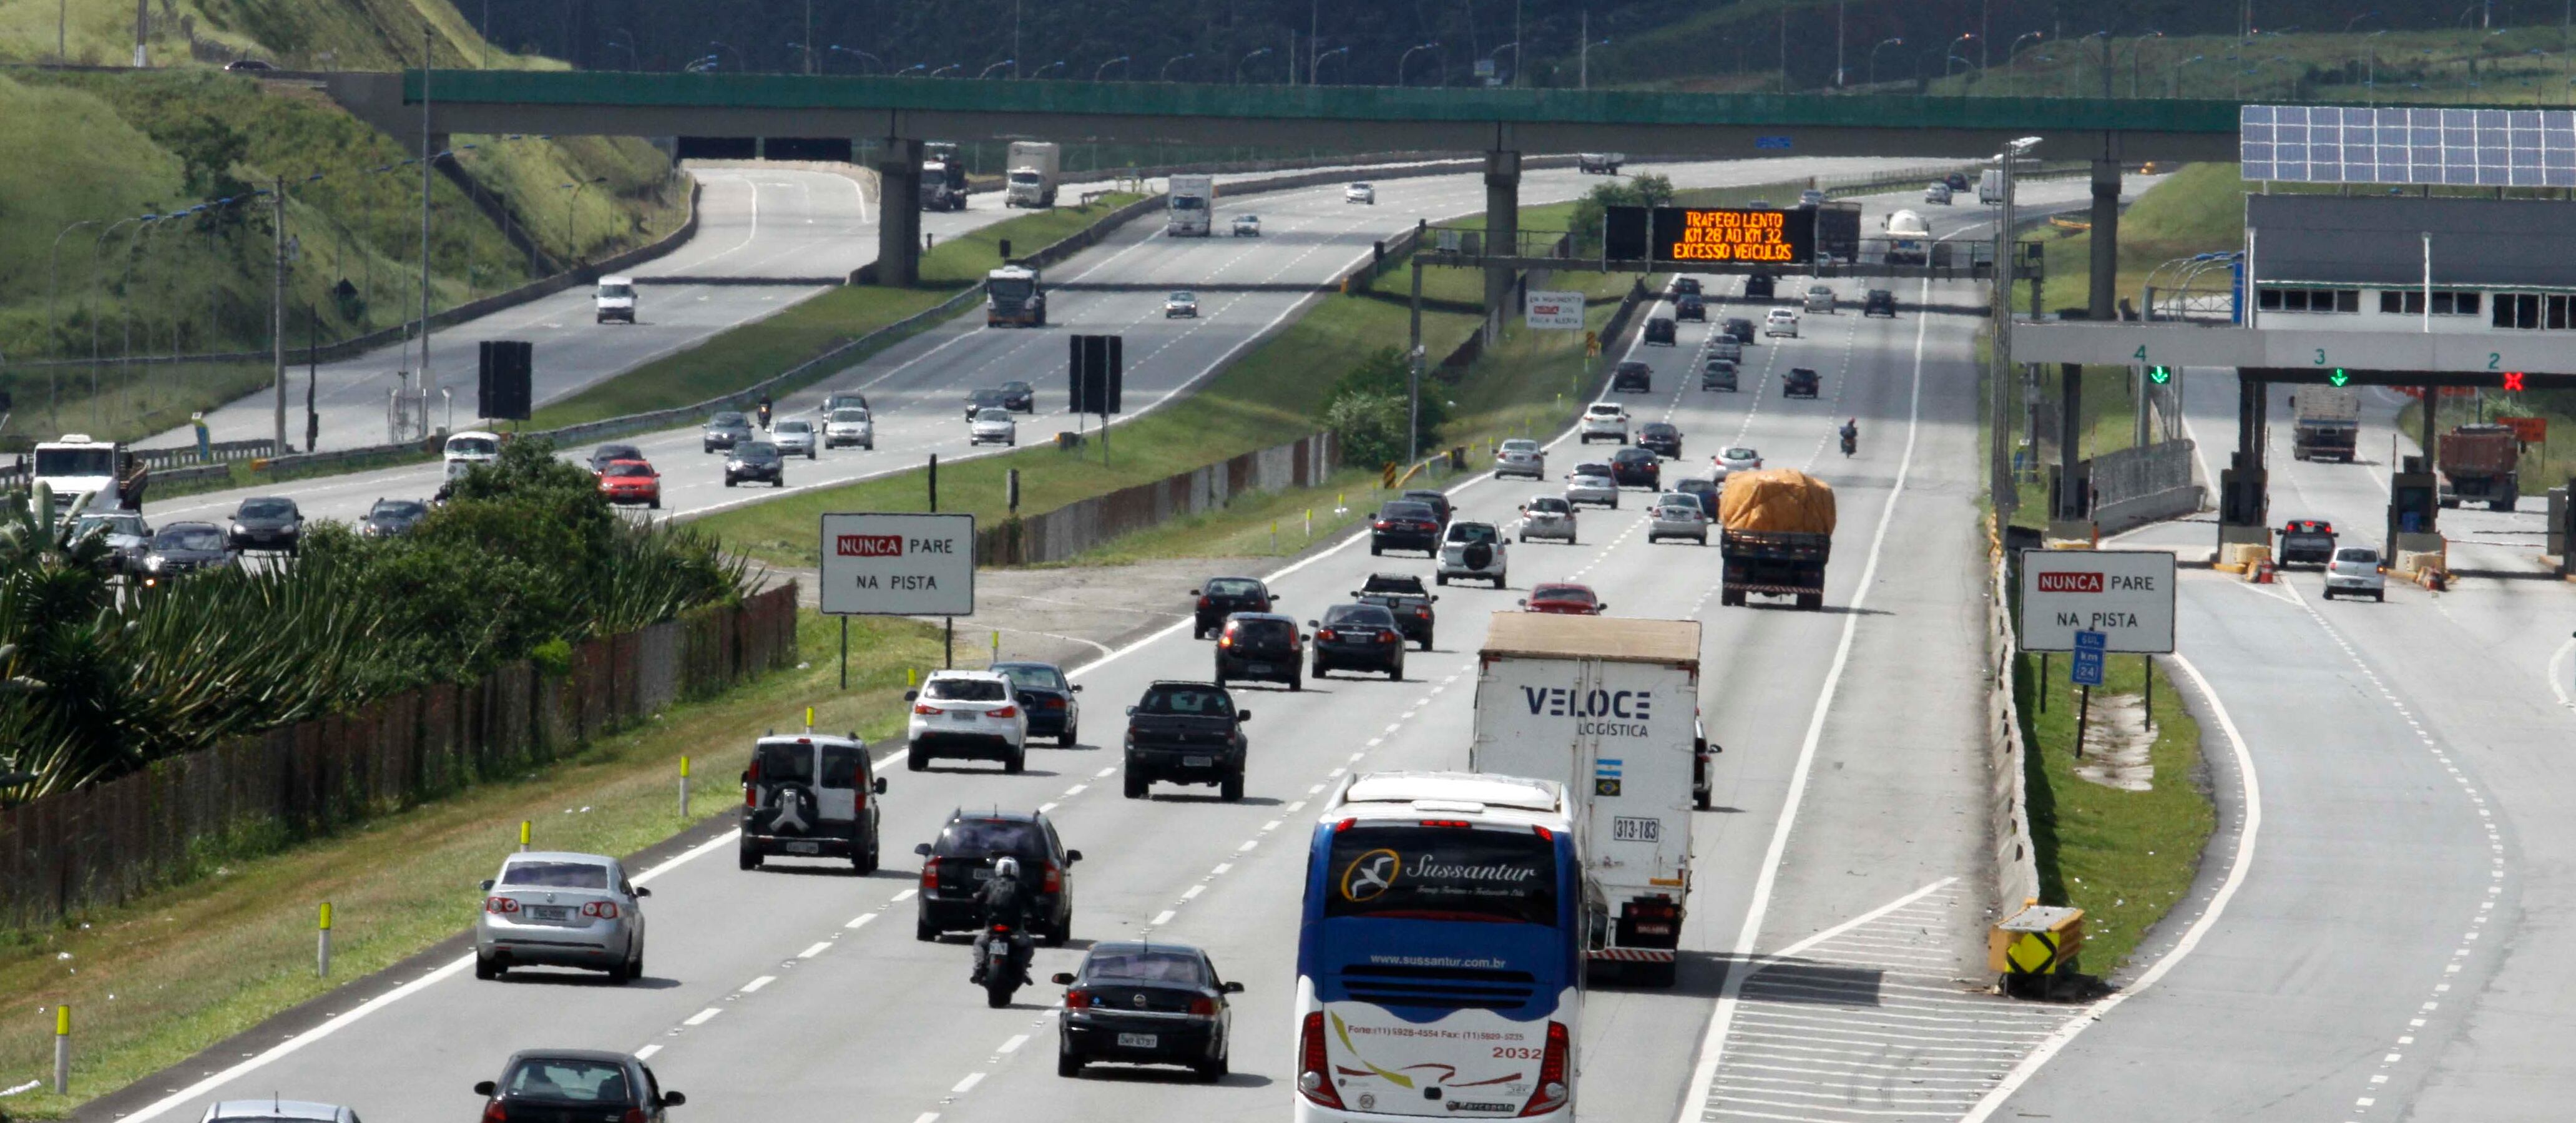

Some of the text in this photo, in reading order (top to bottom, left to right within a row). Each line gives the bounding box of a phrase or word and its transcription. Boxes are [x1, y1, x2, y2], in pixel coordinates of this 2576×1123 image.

[1743, 213, 1783, 228] LENTO
[1685, 228, 1781, 243] KM 28 AO KM 32
[1673, 243, 1730, 258] EXCESSO
[2133, 345, 2147, 361] 4
[2314, 348, 2326, 365] 3
[2489, 352, 2500, 370] 2
[841, 539, 953, 554] NUNCA PARE
[856, 576, 937, 590] NA PISTA
[2042, 576, 2154, 591] NUNCA PARE
[2057, 612, 2138, 627] NA PISTA
[2080, 651, 2098, 662] km
[2079, 666, 2094, 677] 24
[1526, 685, 1651, 720] VELOCE
[1579, 720, 1648, 738] LOGÍSTICA
[1617, 820, 1657, 839] 313-183
[1406, 854, 1537, 881] Sussantur
[1370, 954, 1506, 969] www.sussantur.com.br
[1492, 1046, 1542, 1060] 2032
